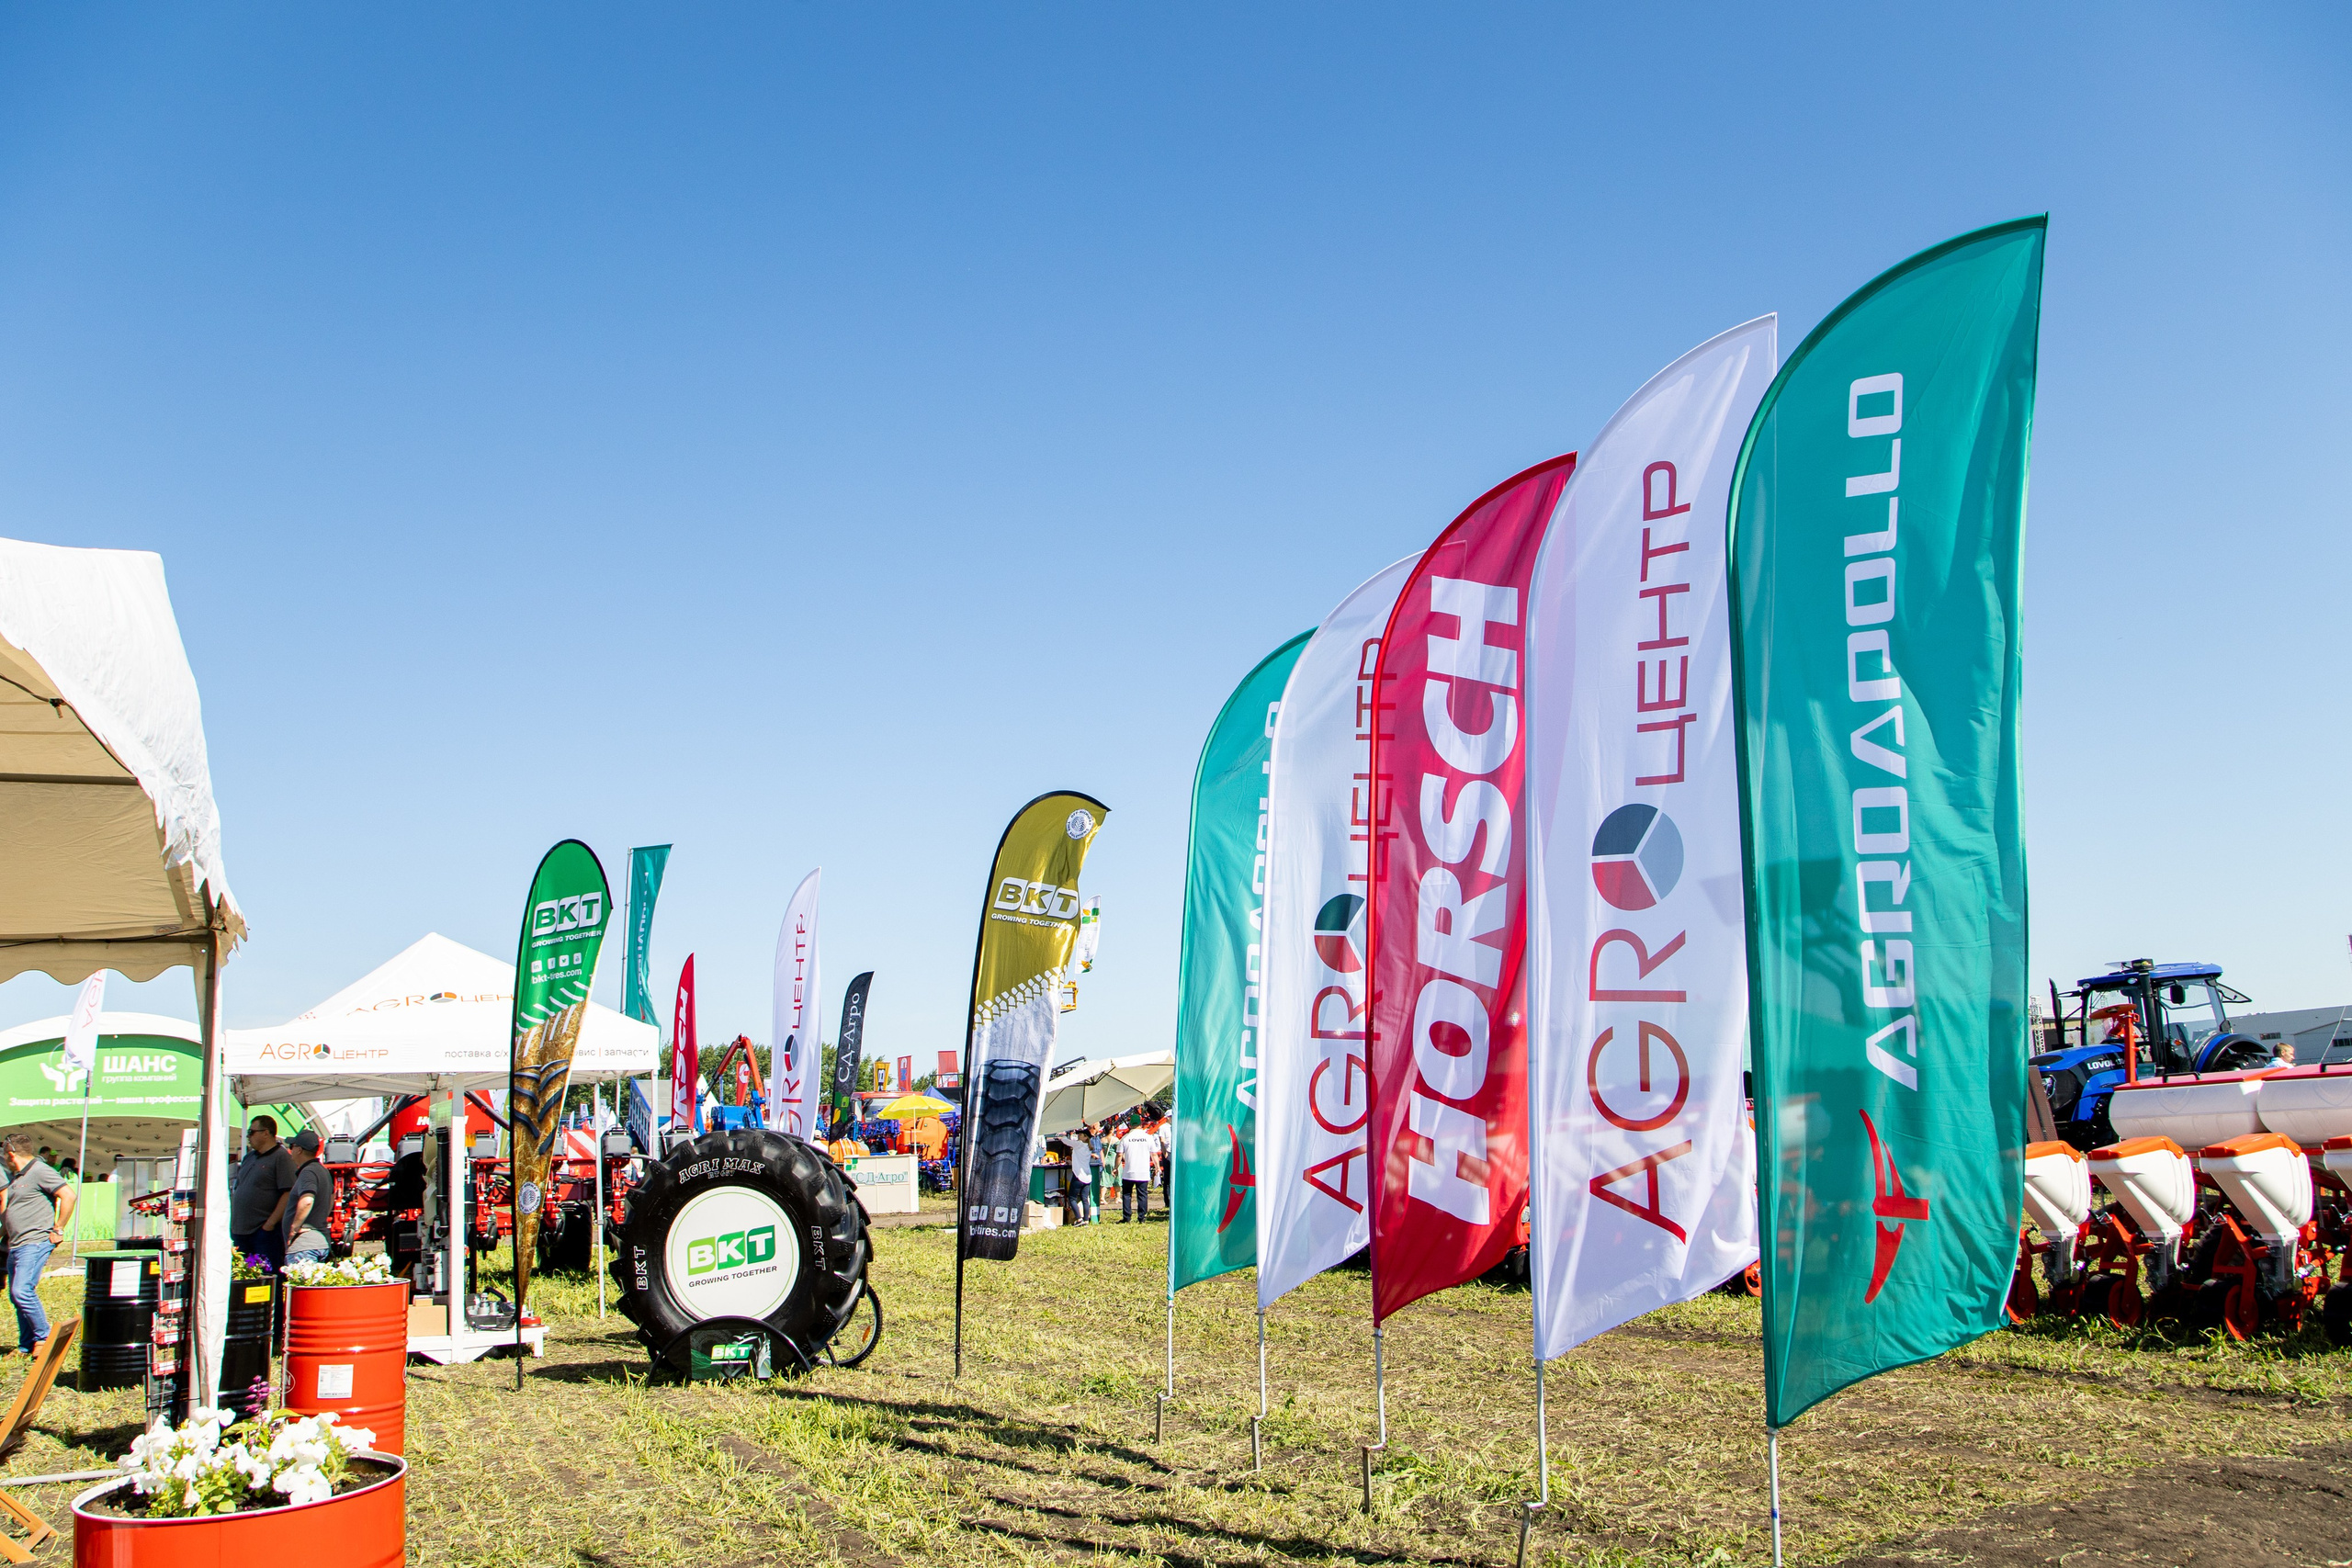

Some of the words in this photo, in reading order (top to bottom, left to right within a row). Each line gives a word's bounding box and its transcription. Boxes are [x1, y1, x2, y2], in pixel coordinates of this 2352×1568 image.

[1843, 371, 1918, 1092] AGROAPOLLO
[993, 877, 1079, 919] BKT
[1408, 575, 1520, 1225] HORSCH
[533, 893, 602, 936] BKT
[991, 912, 1027, 924] GROWING
[532, 937, 563, 949] GROWING
[565, 931, 602, 942] TOGETHER
[532, 969, 582, 985] bkt-tires.com
[838, 992, 862, 1083] СД-Агро
[445, 1049, 492, 1058] поставка
[494, 1048, 509, 1057] с/х
[605, 1047, 650, 1057] запчасти
[102, 1055, 177, 1073] ШАНС
[2086, 1059, 2116, 1070] LOVOL
[102, 1076, 132, 1084] группа
[133, 1074, 177, 1082] компаний
[9, 1097, 51, 1107] Защита
[51, 1095, 102, 1107] растеий
[116, 1096, 144, 1104] наша
[678, 1157, 720, 1184] AGRI
[722, 1157, 765, 1175] MAX
[687, 1224, 775, 1276] BKT
[811, 1226, 826, 1271] BKT
[633, 1246, 649, 1291] BKT
[688, 1275, 729, 1288] GROWING
[731, 1266, 778, 1280] TOGETHER
[711, 1344, 752, 1359] BKT
